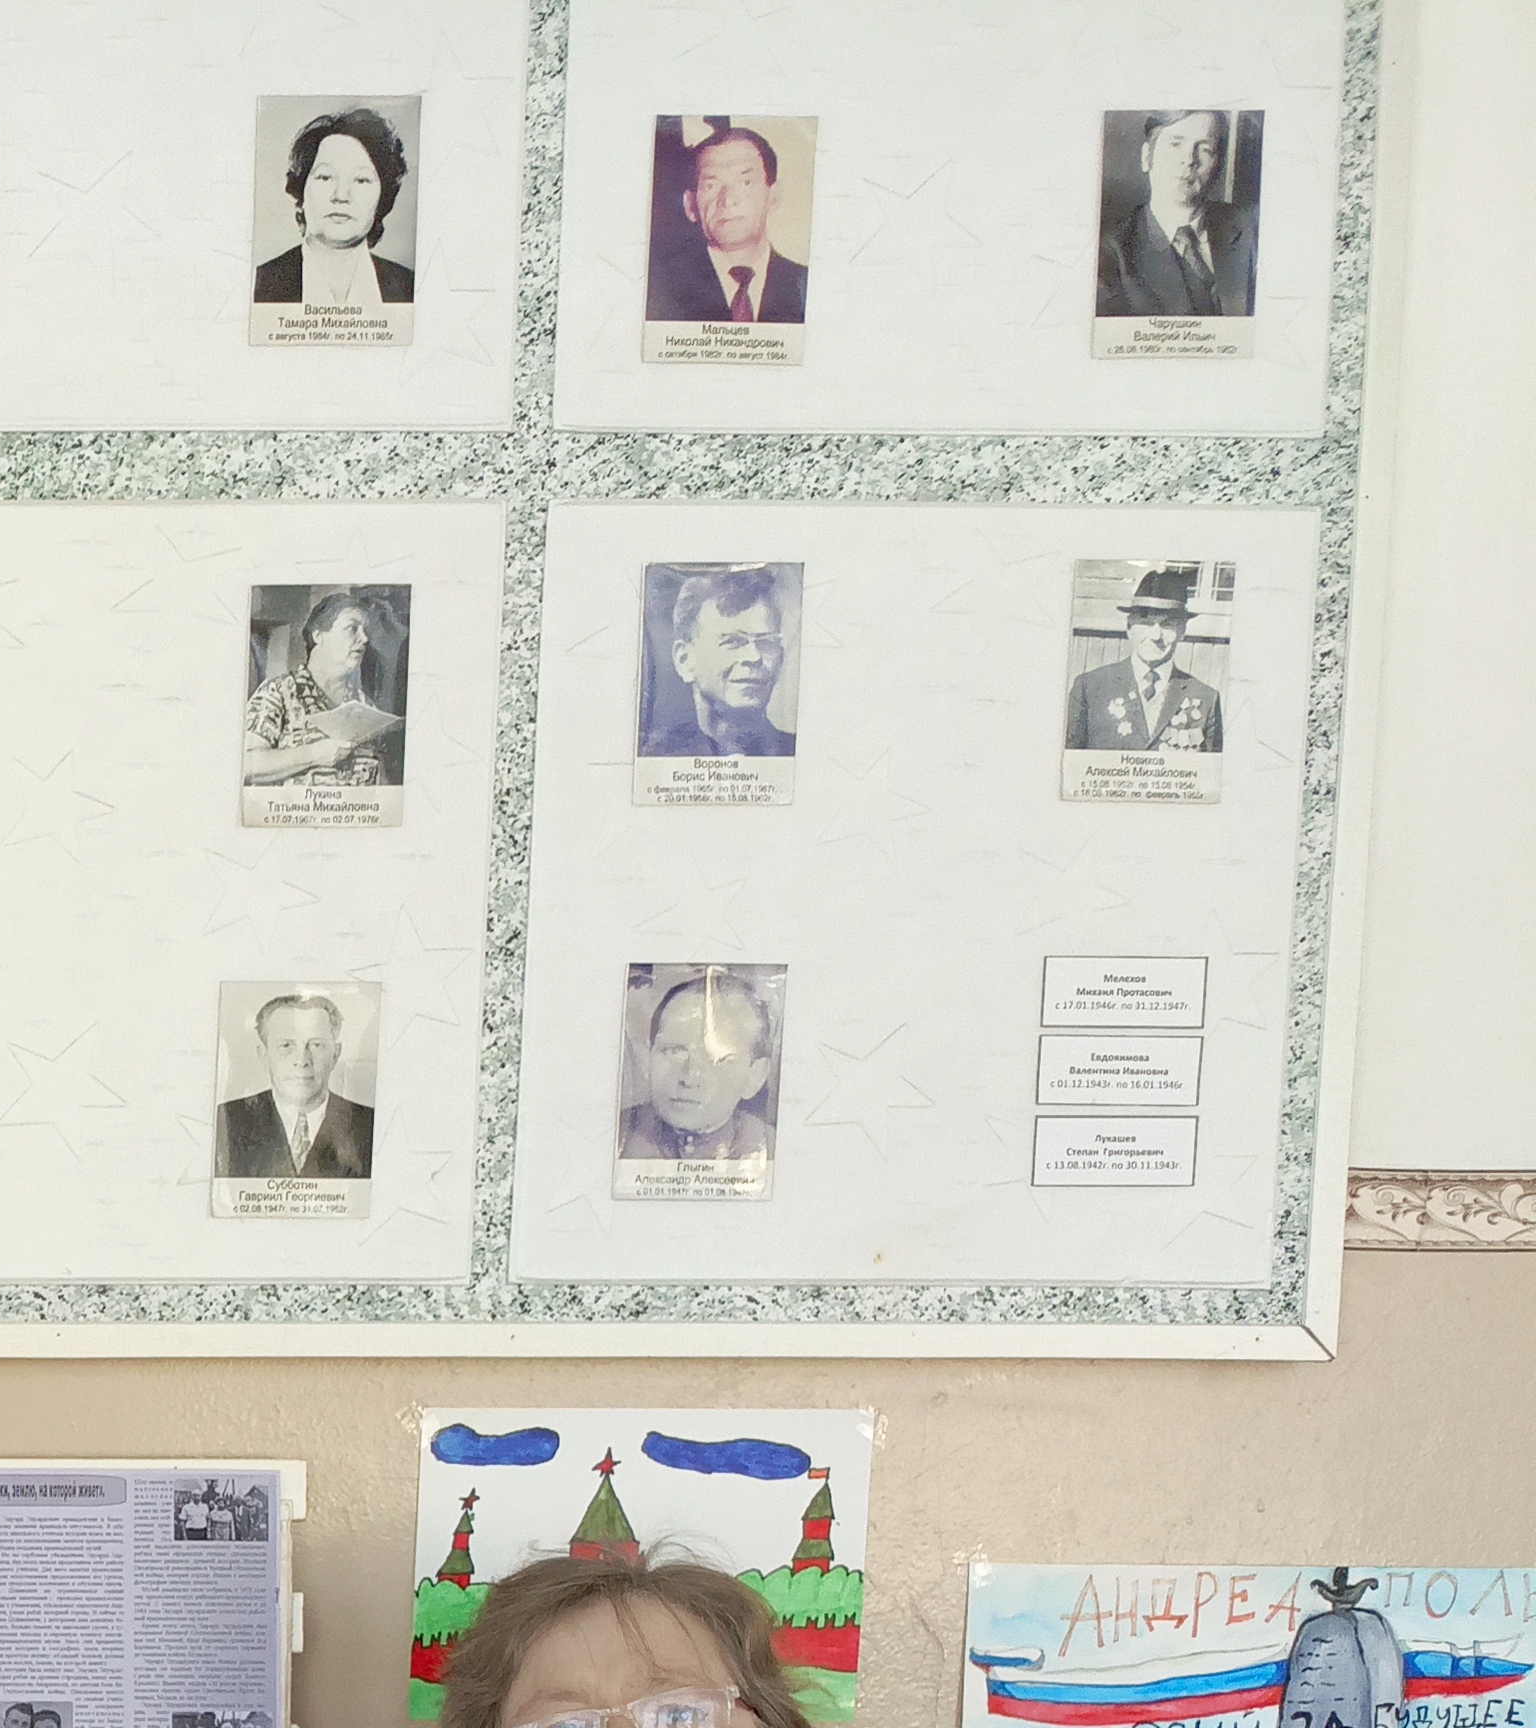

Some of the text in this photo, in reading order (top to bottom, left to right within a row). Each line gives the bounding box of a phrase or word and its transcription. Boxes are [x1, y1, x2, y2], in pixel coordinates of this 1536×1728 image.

[304, 304, 362, 315] Васильева
[278, 317, 388, 330] Тамара Михайловна
[702, 324, 750, 336] Мальцев
[1133, 330, 1180, 342] Валерий
[666, 336, 785, 349] Николай Никандрович
[694, 758, 739, 771] Воронов
[1120, 753, 1165, 765] Новиков
[672, 771, 759, 783] Борис Иванович
[1085, 766, 1198, 778] Алексей Михайлович
[304, 788, 342, 801] Лукина
[268, 802, 379, 812] Татьяна Михайловна
[1103, 974, 1146, 983] Мелехов
[1076, 988, 1173, 998] Михаил Протасович
[1091, 1053, 1150, 1063] Евдокимова
[1069, 1067, 1169, 1076] Валентина Ивановна
[1094, 1135, 1136, 1144] Лукашев
[1066, 1148, 1164, 1158] Степан Григорьевич
[267, 1179, 318, 1192] Субботин
[634, 1174, 691, 1185] Александр
[239, 1191, 345, 1202] Гавриил Георгиевич
[39, 1484, 48, 1498] на
[49, 1479, 76, 1502] которой
